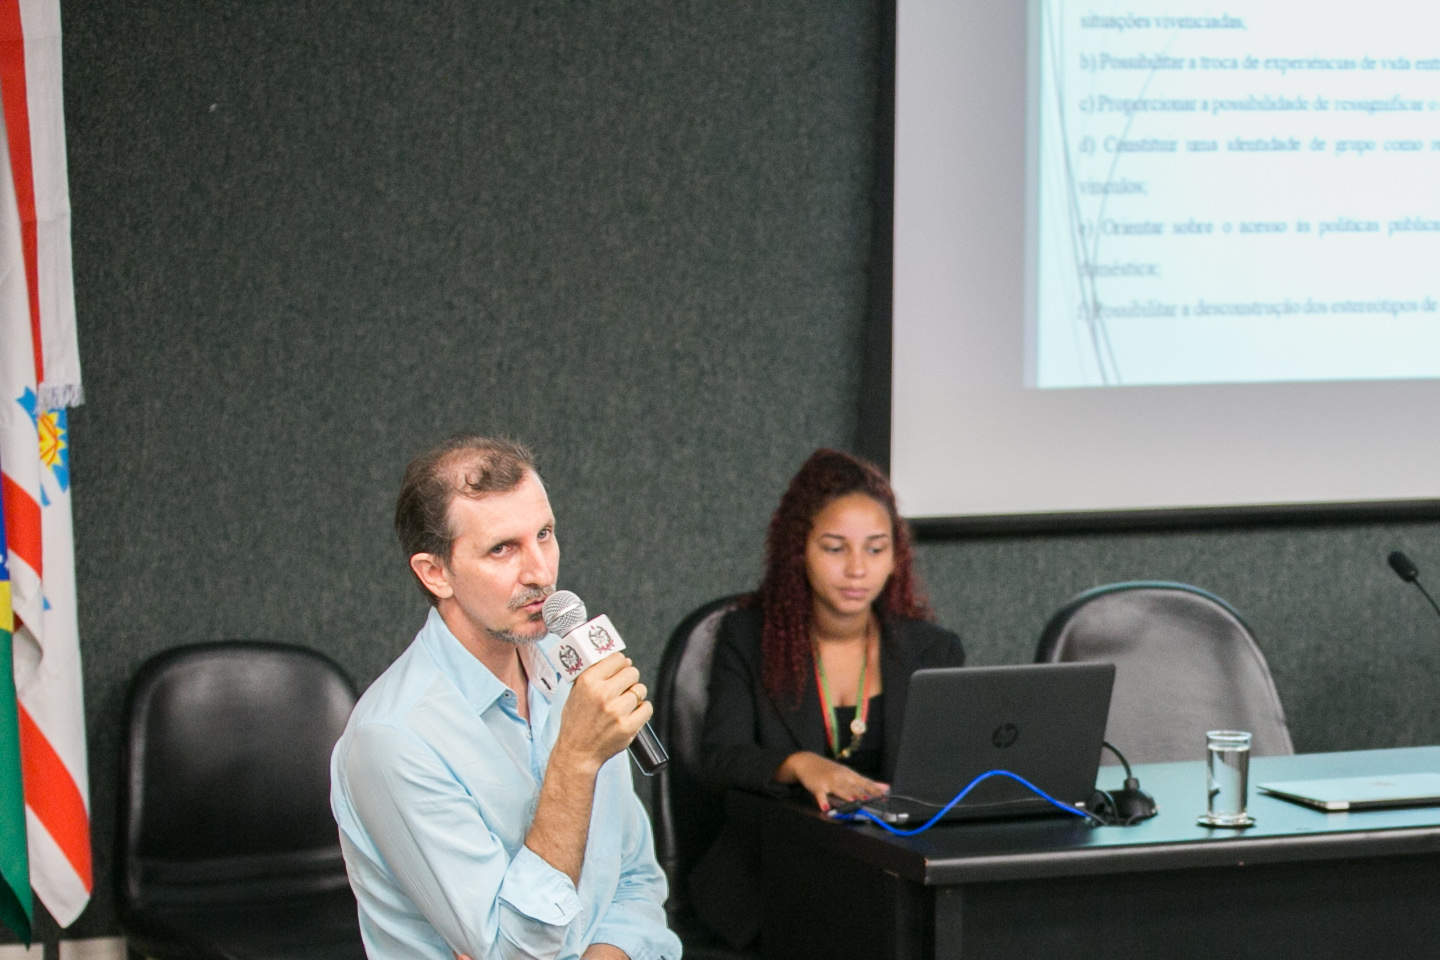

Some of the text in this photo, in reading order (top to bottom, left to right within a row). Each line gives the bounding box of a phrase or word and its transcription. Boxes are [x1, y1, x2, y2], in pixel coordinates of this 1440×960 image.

[1080, 11, 1151, 32] situações
[1079, 52, 1096, 73] b)
[1099, 52, 1185, 71] Possibilitar
[1188, 58, 1197, 70] a
[1200, 56, 1238, 70] troca
[1241, 54, 1259, 70] de
[1263, 54, 1356, 75] experiências
[1360, 55, 1377, 71] de
[1381, 56, 1411, 71] vida
[1078, 94, 1095, 116] c)
[1097, 94, 1197, 116] Proporcionar
[1200, 99, 1209, 112] a
[1212, 94, 1309, 116] possibilidade
[1312, 95, 1329, 112] de
[1334, 95, 1423, 117] ressignificar
[1078, 135, 1096, 157] d)
[1103, 134, 1178, 153] Constituir
[1185, 139, 1219, 152] uma
[1226, 135, 1301, 152] identidade
[1308, 135, 1326, 152] de
[1335, 139, 1376, 157] grupo
[1383, 140, 1424, 152] como
[1102, 217, 1164, 236] Orientar
[1173, 217, 1213, 234] sobre
[1239, 222, 1287, 234] acesso
[1319, 216, 1380, 238] políticas
[1095, 298, 1178, 319] Possibilitar
[1181, 305, 1190, 317] a
[1193, 298, 1301, 318] desconstrução
[1303, 297, 1327, 314] dos
[1331, 296, 1418, 317] estereótipos
[1421, 295, 1438, 313] de
